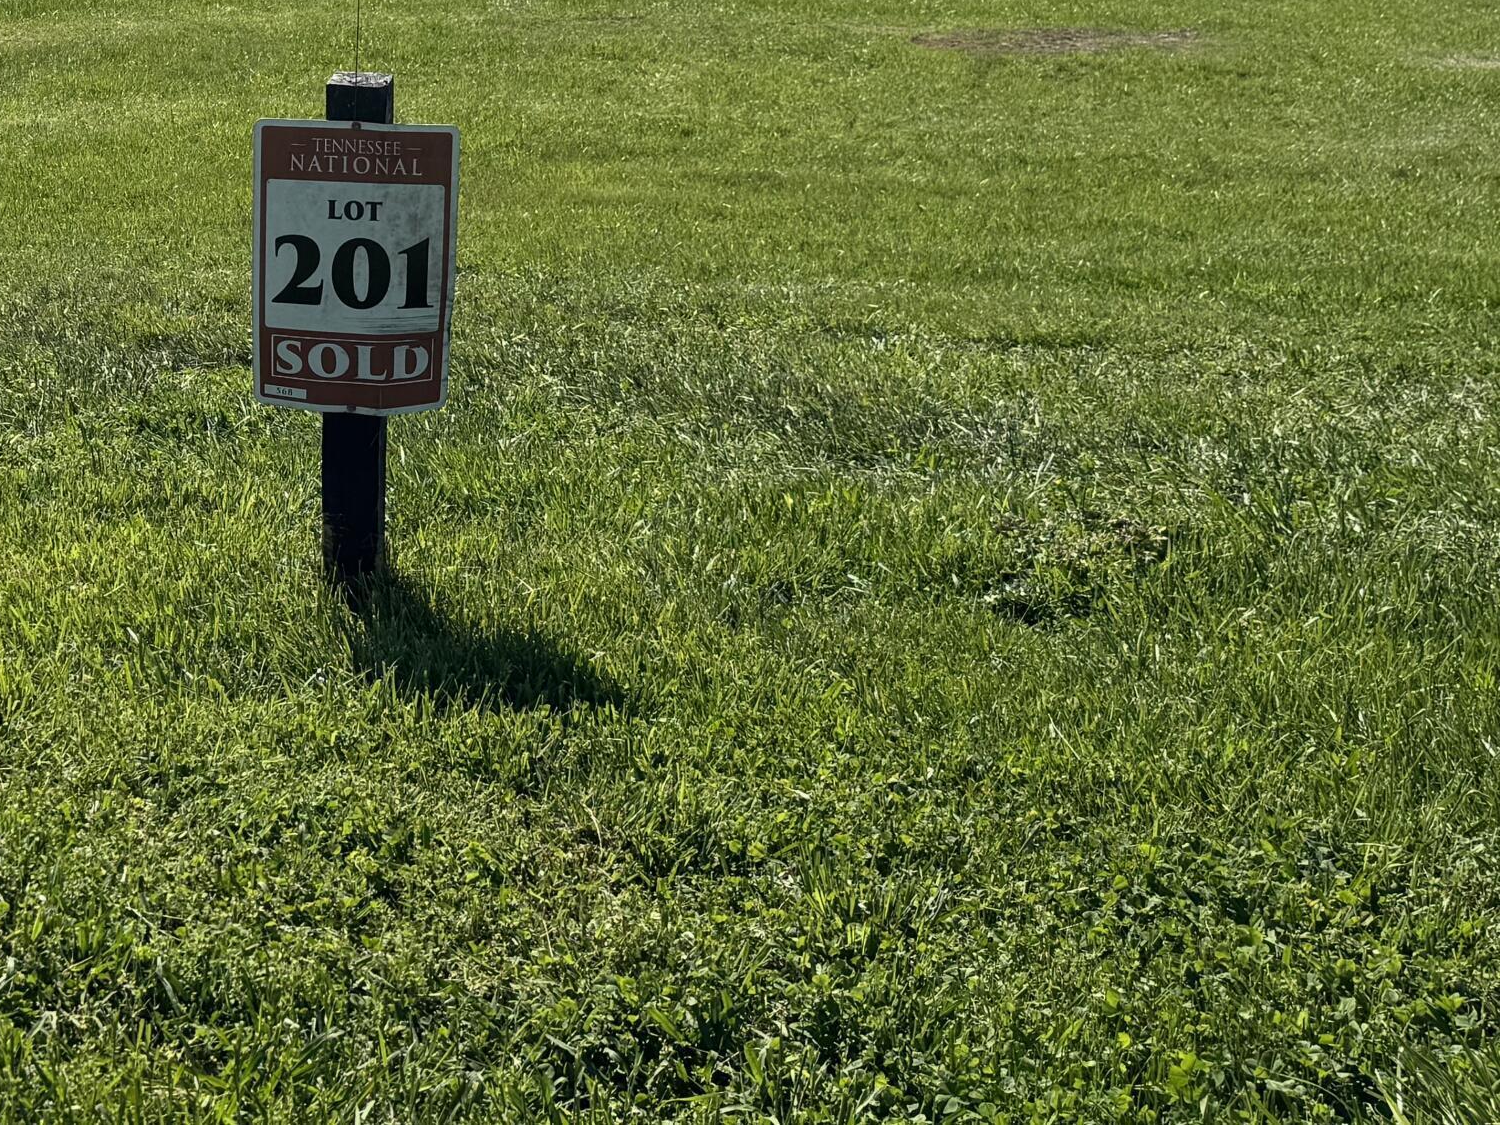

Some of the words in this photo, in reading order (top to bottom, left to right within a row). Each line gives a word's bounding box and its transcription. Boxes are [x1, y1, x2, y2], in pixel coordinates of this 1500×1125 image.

[312, 137, 401, 156] TENNESSEE
[289, 154, 423, 176] NATIONAL
[327, 199, 383, 222] LOT
[271, 234, 434, 310] 201
[276, 339, 430, 381] SOLD
